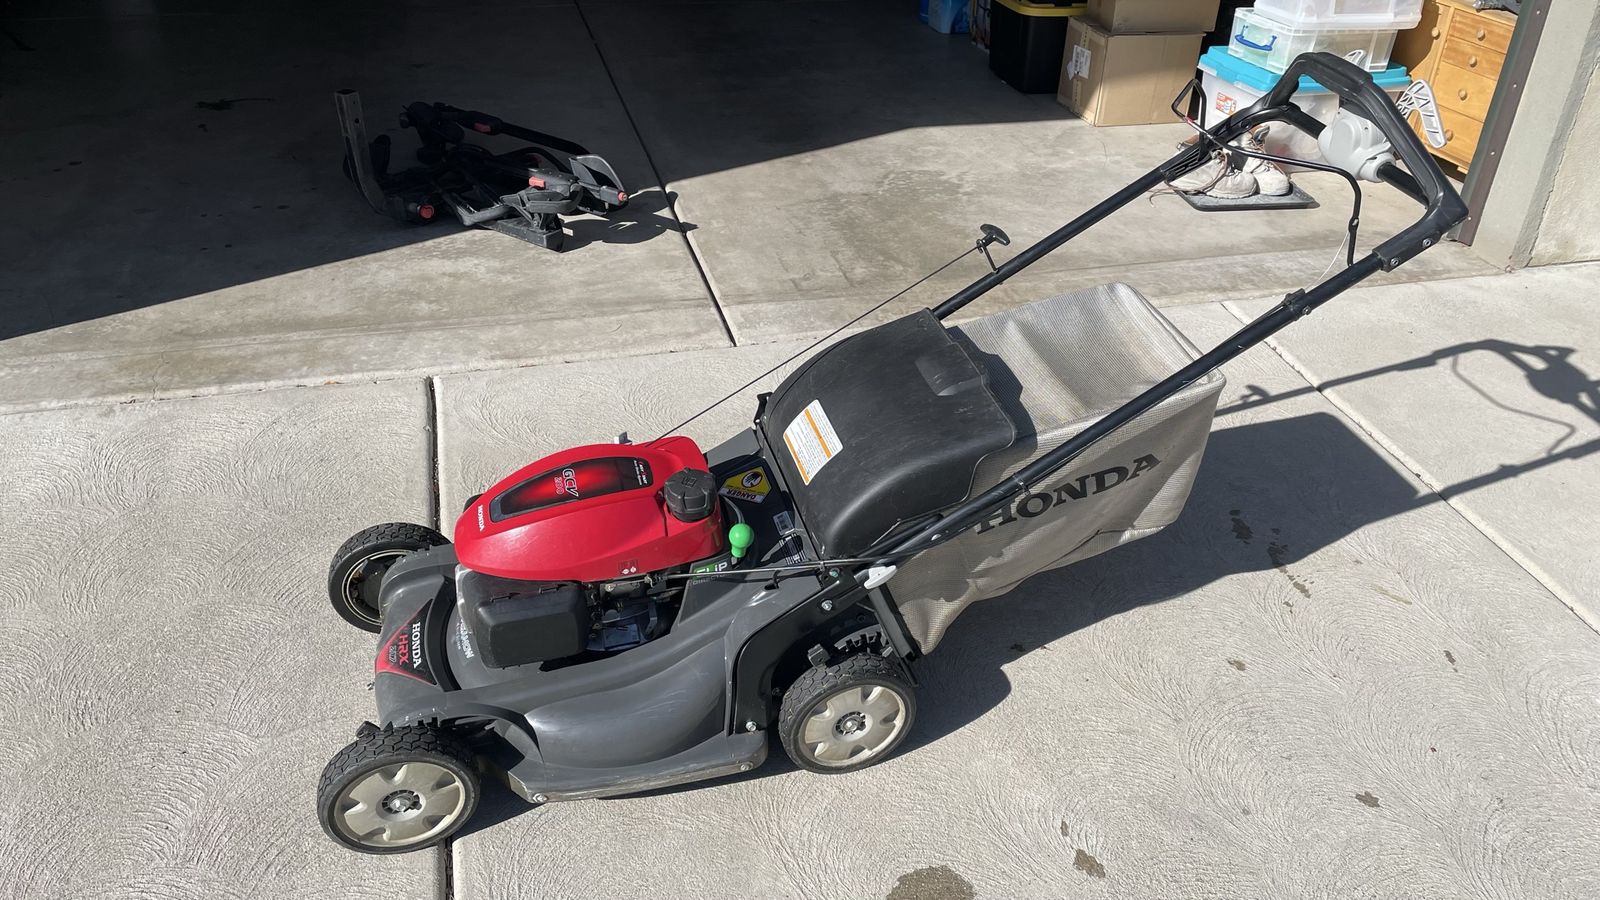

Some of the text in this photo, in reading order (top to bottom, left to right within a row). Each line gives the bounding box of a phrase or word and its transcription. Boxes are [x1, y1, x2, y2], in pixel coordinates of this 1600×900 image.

[562, 468, 579, 497] GCV
[977, 453, 1161, 535] HONDA
[477, 504, 485, 532] HONDA
[398, 634, 409, 666] HRX
[411, 621, 422, 669] HONDA
